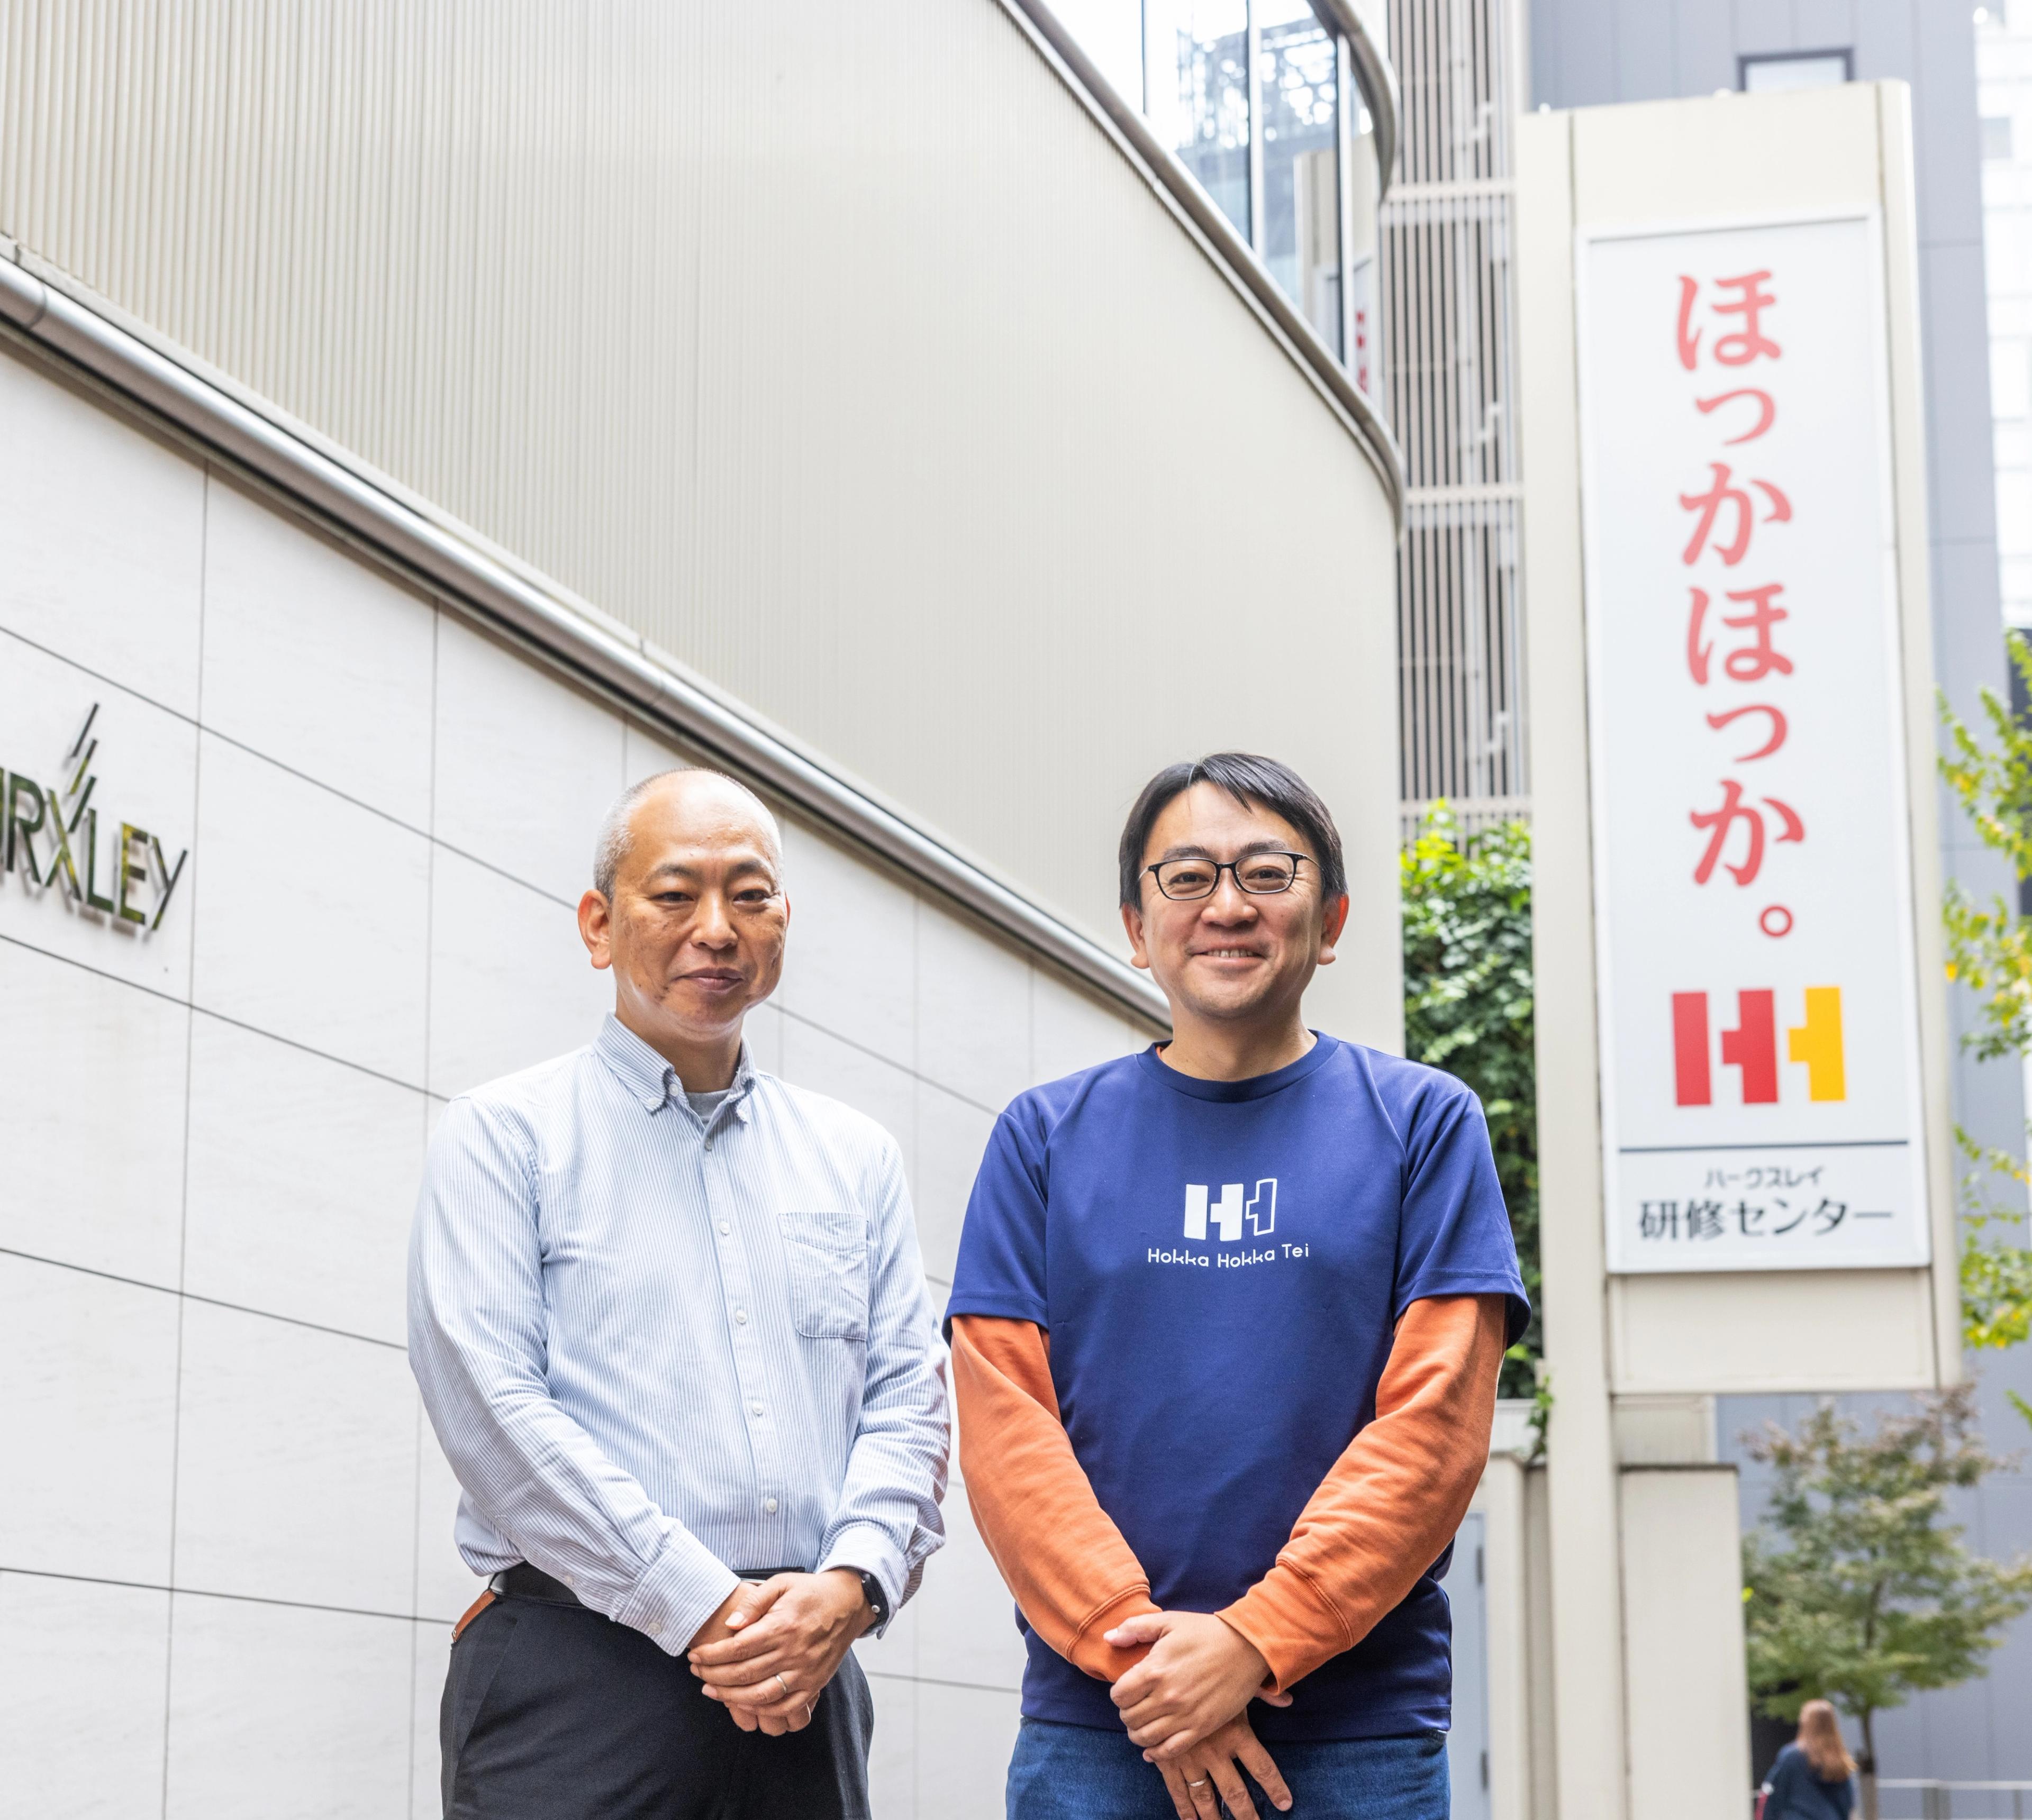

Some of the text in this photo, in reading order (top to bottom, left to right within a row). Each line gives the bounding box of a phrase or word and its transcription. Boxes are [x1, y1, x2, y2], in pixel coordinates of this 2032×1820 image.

[0, 766, 188, 931] RXLEY
[1704, 1166, 1824, 1189] ハークスレイ
[1639, 1198, 1893, 1241] 研修センター
[1147, 1243, 1309, 1268] Hokka Hokka Tei
